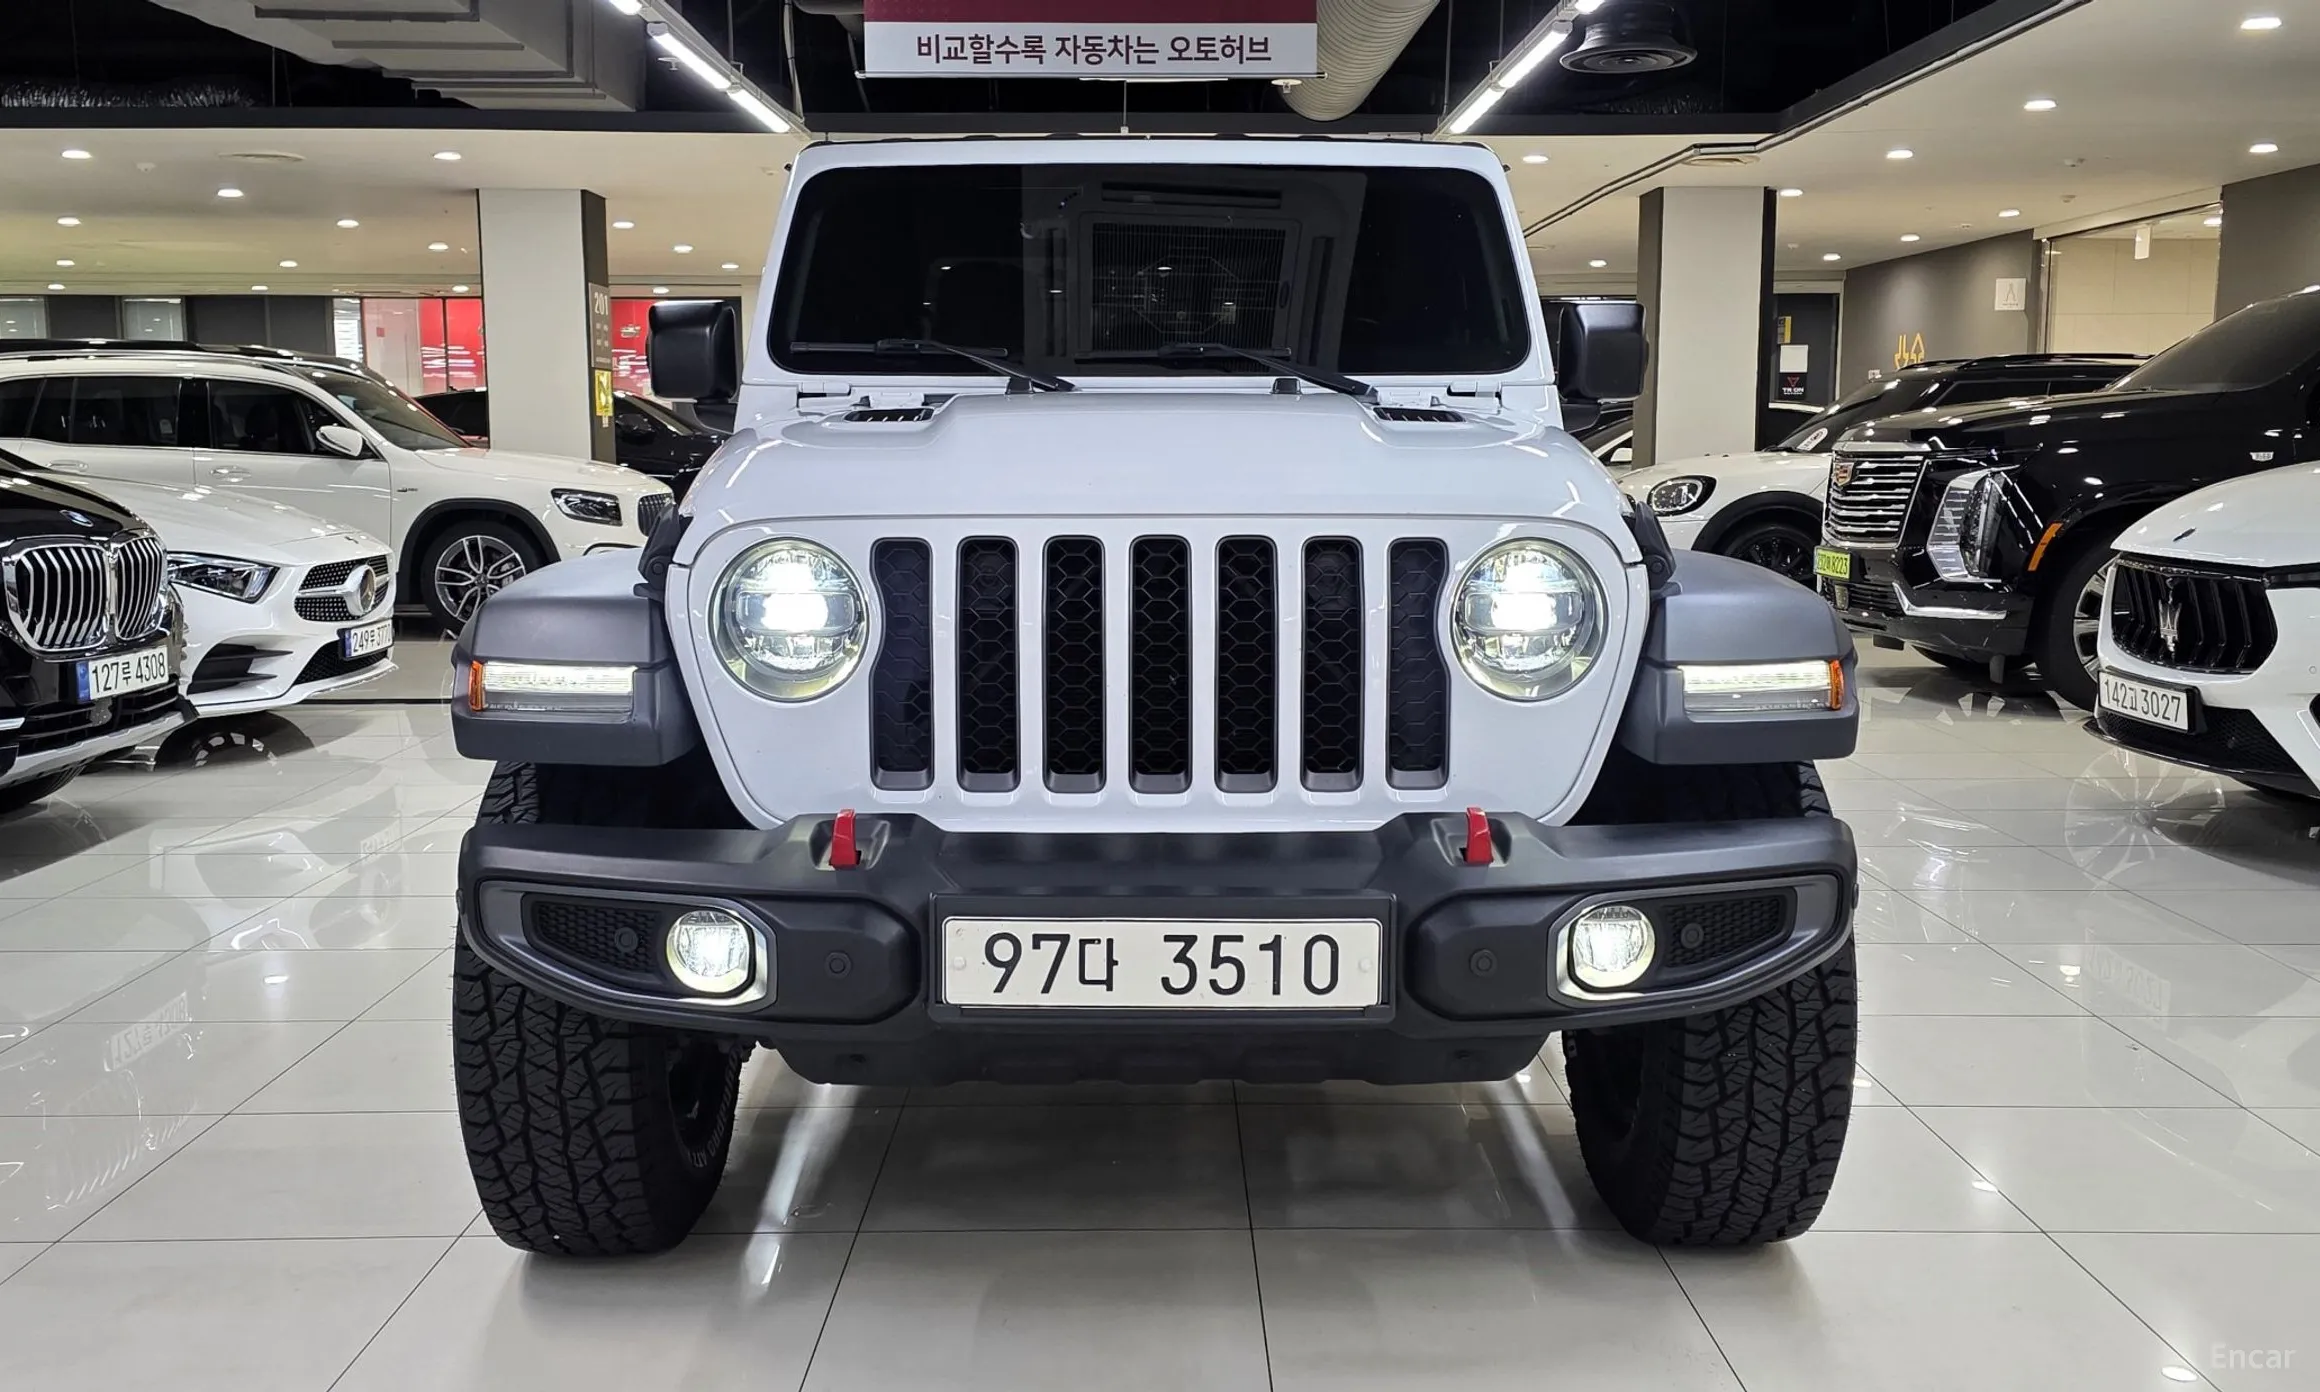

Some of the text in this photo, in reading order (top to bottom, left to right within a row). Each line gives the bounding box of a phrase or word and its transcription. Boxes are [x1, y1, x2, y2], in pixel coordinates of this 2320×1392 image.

[917, 34, 1272, 65] 비교할수록 자동차는 오토허브
[594, 291, 609, 316] 201
[92, 652, 166, 693] 127루 4308
[2141, 689, 2181, 723] 3027
[984, 932, 1340, 996] 97다 3510
